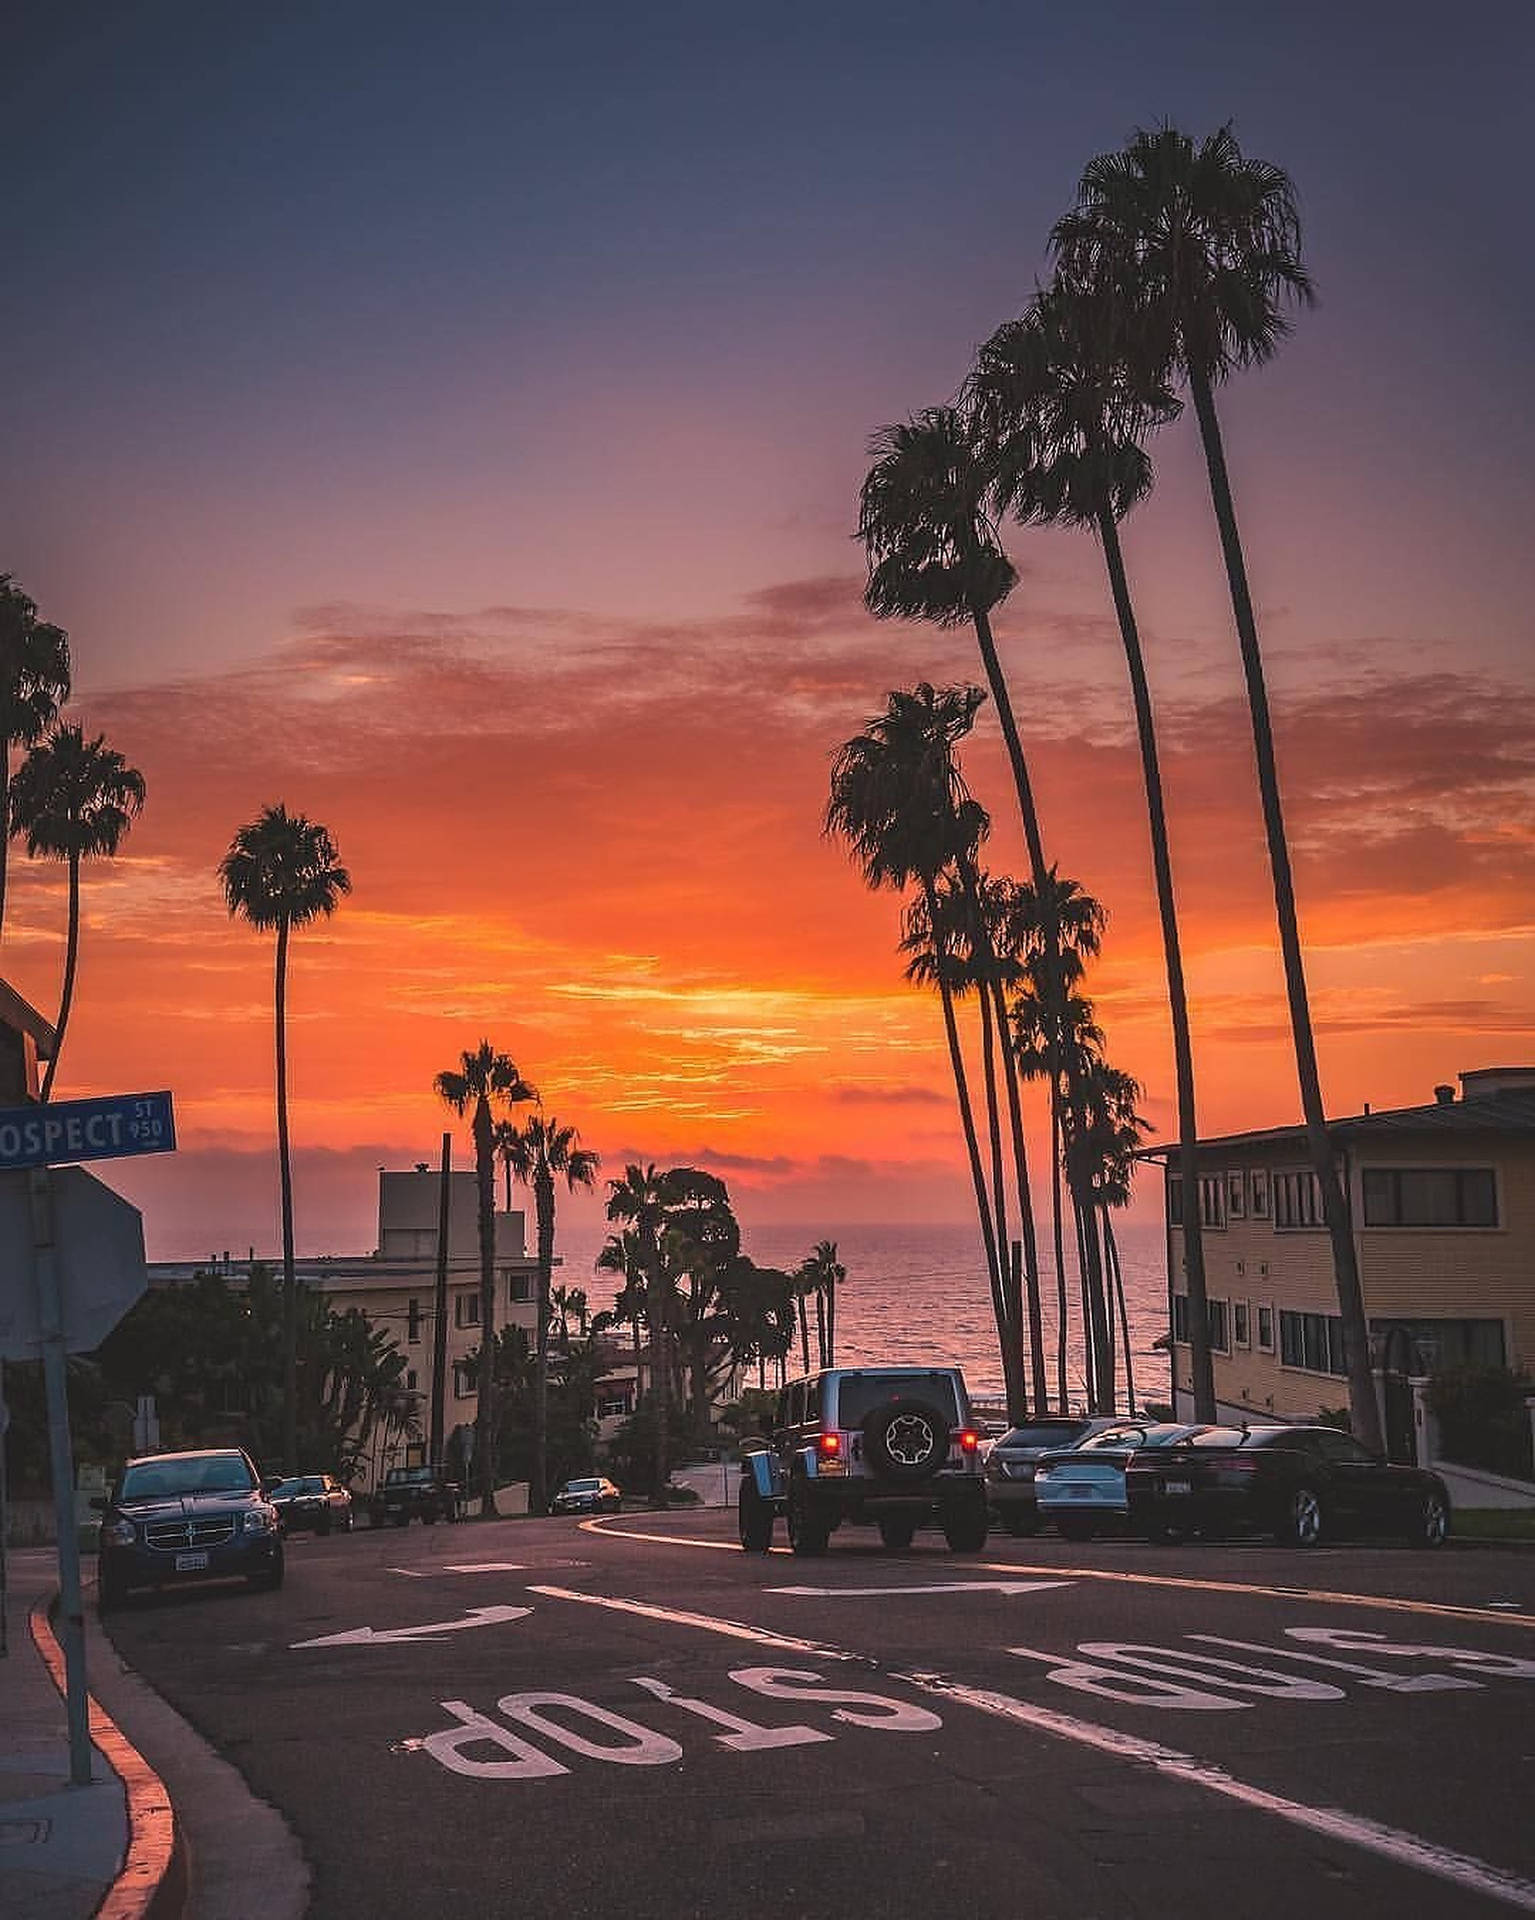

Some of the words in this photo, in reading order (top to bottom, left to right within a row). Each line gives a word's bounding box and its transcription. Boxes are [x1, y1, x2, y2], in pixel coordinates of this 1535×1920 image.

[0, 1113, 122, 1156] OSPECT
[135, 1101, 152, 1117] ST
[1005, 1627, 1535, 1710] STOP
[424, 1666, 943, 1778] STOP
